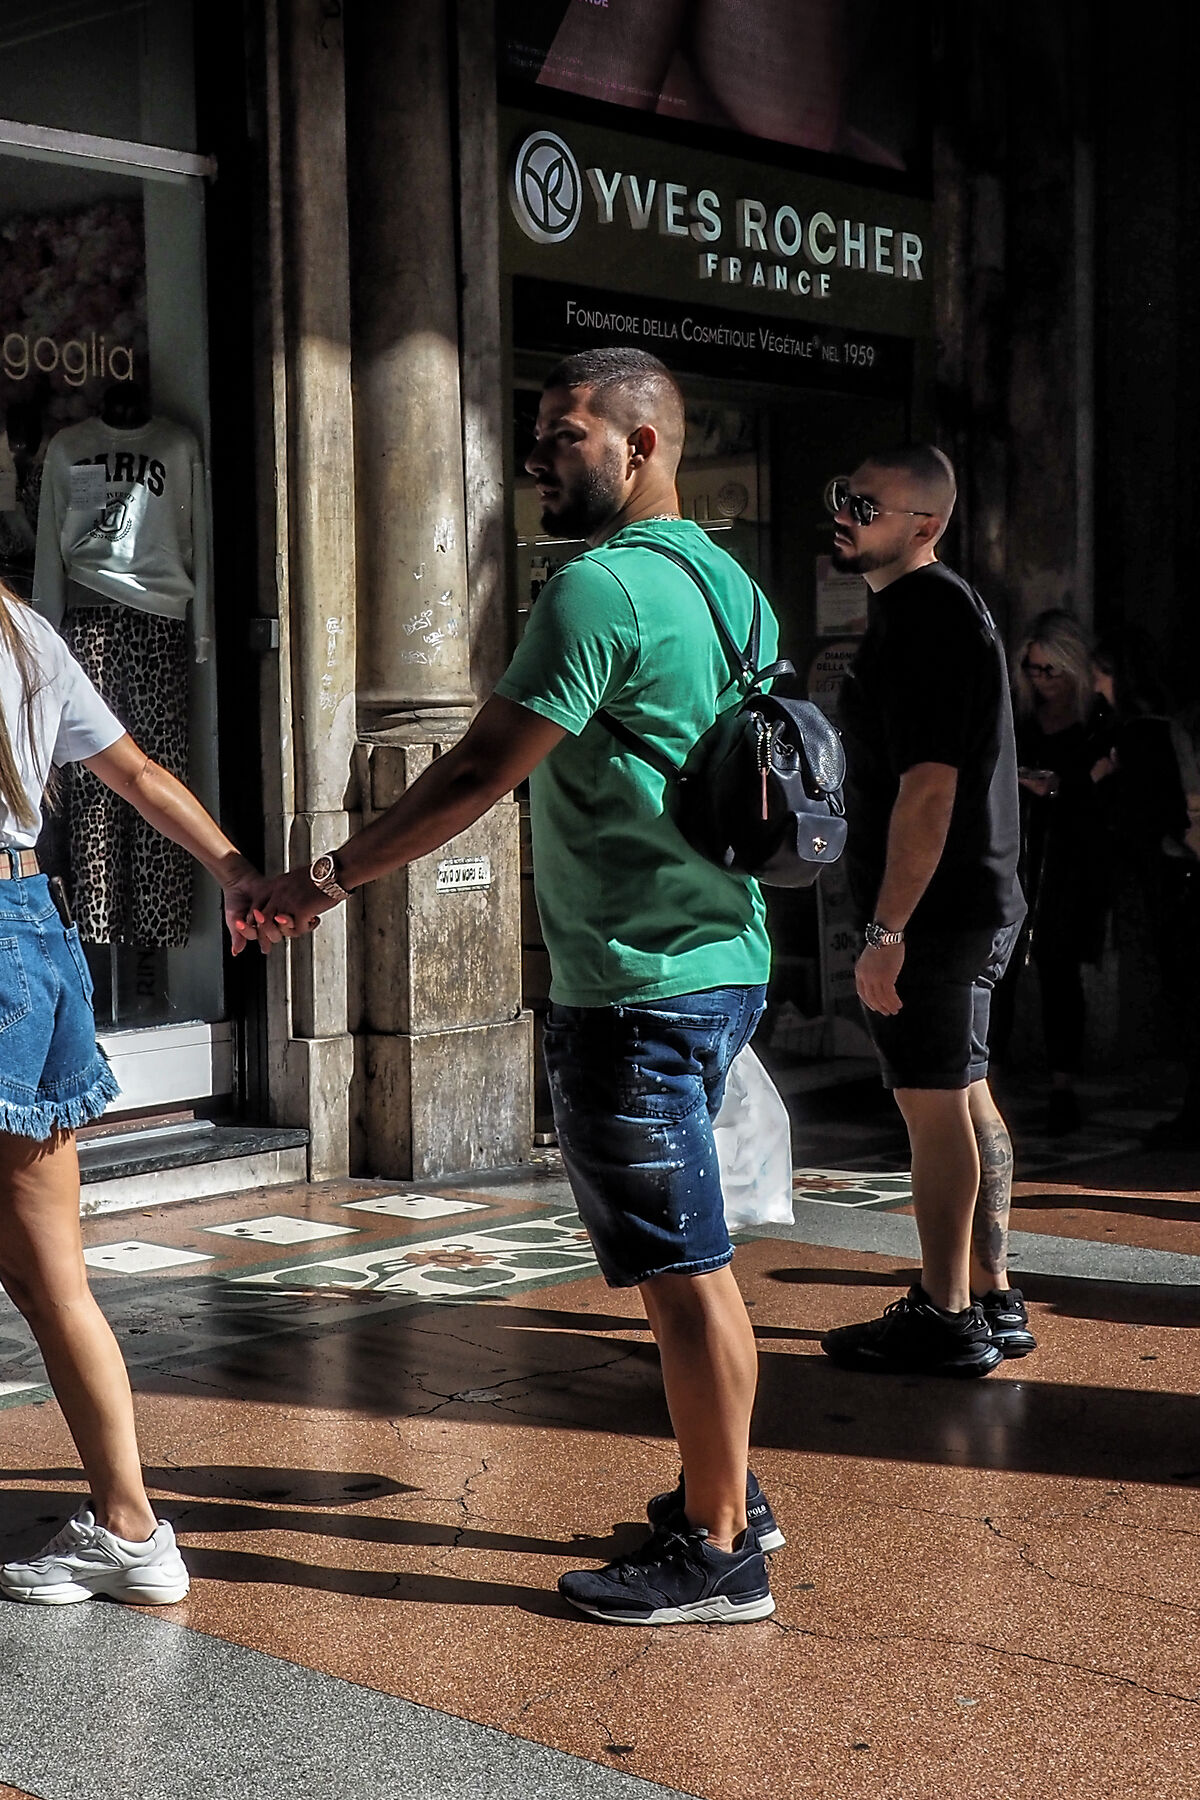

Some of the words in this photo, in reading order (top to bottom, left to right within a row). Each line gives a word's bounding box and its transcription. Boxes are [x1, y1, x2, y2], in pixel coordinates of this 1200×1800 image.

[587, 168, 724, 243] YVES
[736, 198, 924, 281] ROCHER
[700, 252, 832, 298] FRANCE
[566, 300, 640, 335] FONDATORE
[643, 318, 679, 340] DELLA
[821, 345, 841, 363] NEL
[843, 342, 875, 367] 1959
[72, 452, 167, 498] ARIS
